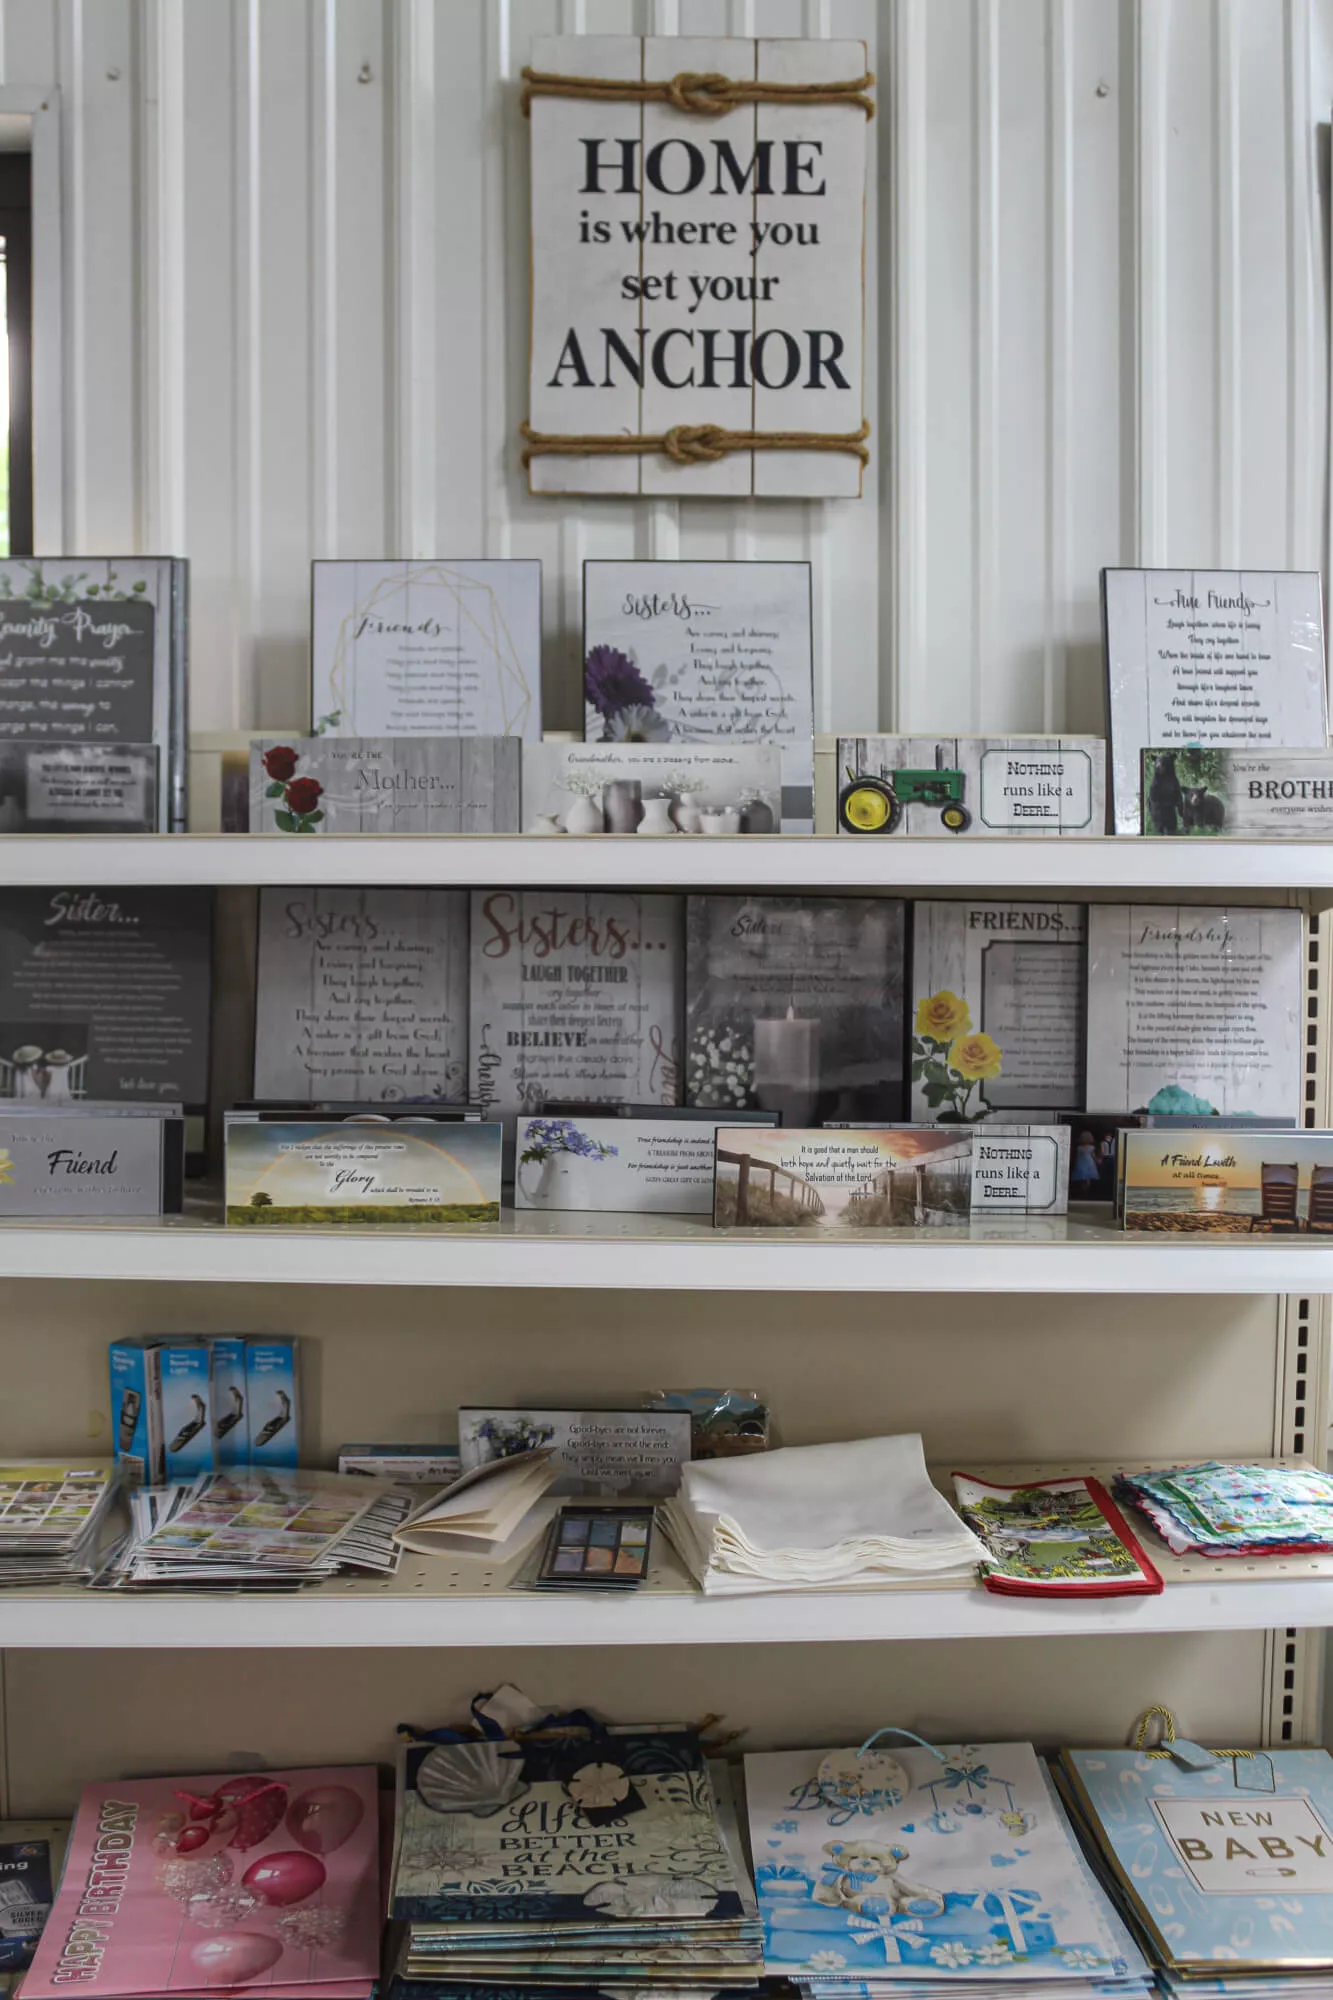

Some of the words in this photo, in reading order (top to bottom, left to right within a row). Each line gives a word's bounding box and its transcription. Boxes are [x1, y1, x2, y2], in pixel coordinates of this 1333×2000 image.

[578, 138, 826, 195] HOME
[579, 211, 611, 244] is
[620, 211, 737, 244] where
[749, 221, 820, 257] you
[621, 271, 678, 300] set
[688, 276, 779, 313] your
[547, 328, 851, 389] ANCHOR
[1007, 761, 1064, 776] NOTHING
[1003, 786, 1034, 797] runs
[1038, 783, 1061, 797] like
[1066, 787, 1073, 797] a
[44, 892, 140, 925] Sister...
[482, 892, 667, 959] Sisters...
[521, 964, 562, 983] LAUGH
[567, 965, 628, 984] TOGETHER
[506, 1031, 588, 1047] BELIEVE
[47, 1149, 119, 1175] Friend
[979, 1147, 1032, 1160] NOTHING
[330, 1168, 375, 1194] Glory
[975, 1169, 1005, 1179] runs
[1007, 1164, 1030, 1179] like
[1032, 1169, 1040, 1179] a
[1201, 1811, 1273, 1826] NEW
[500, 1833, 638, 1850] BETTER
[1178, 1835, 1326, 1861] BABY
[79, 1799, 139, 1915] BIRTHDAY
[565, 1849, 620, 1862] the
[502, 1862, 635, 1876] BEACH
[53, 1919, 114, 1983] HAPPY
